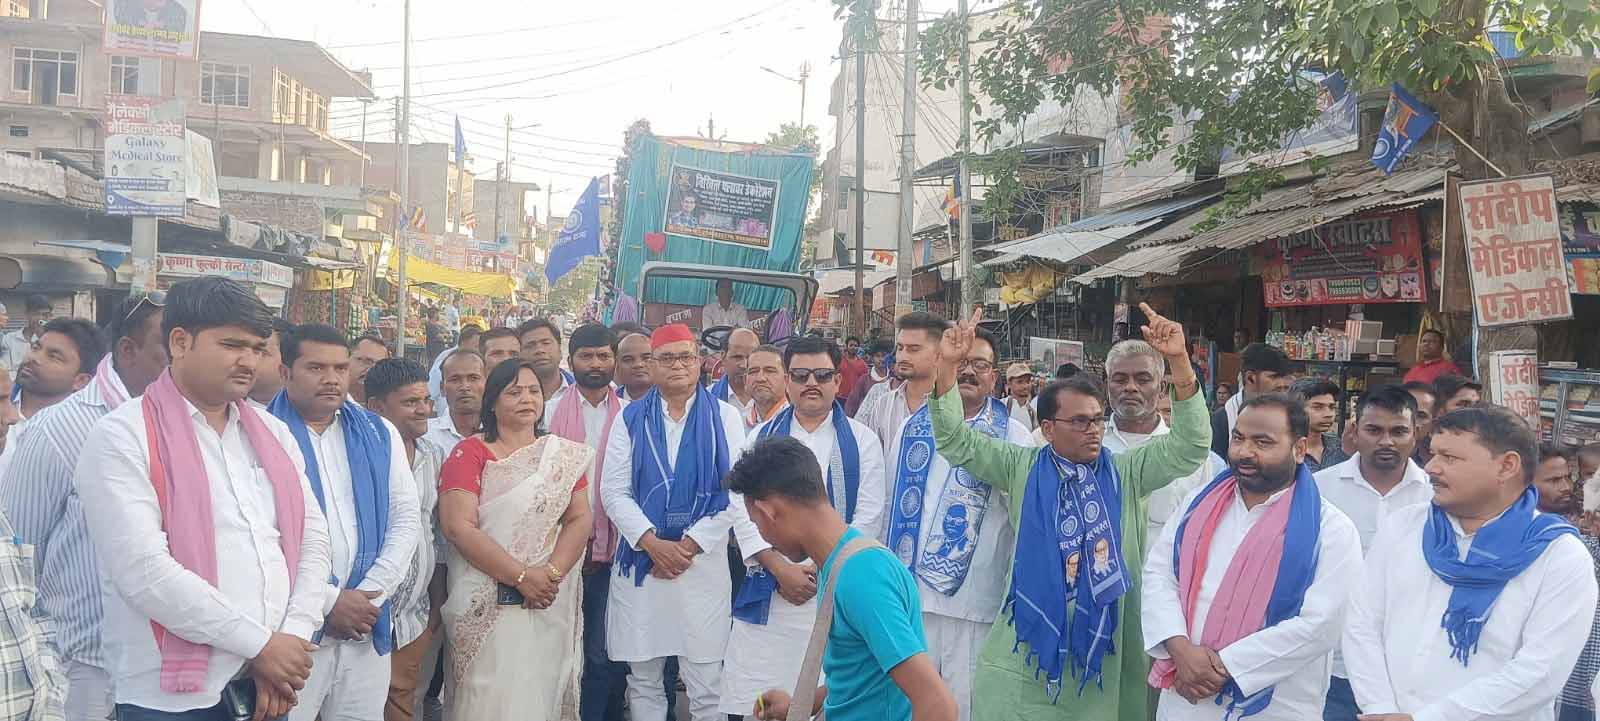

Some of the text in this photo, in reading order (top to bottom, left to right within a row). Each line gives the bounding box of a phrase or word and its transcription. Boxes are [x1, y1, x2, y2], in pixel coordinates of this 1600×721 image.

[111, 150, 183, 162] Medical Store
[125, 137, 167, 148] Galaxy
[1464, 182, 1553, 231] संदीप
[1470, 234, 1562, 277] मेडिकल
[1478, 278, 1568, 322] एजेन्सी
